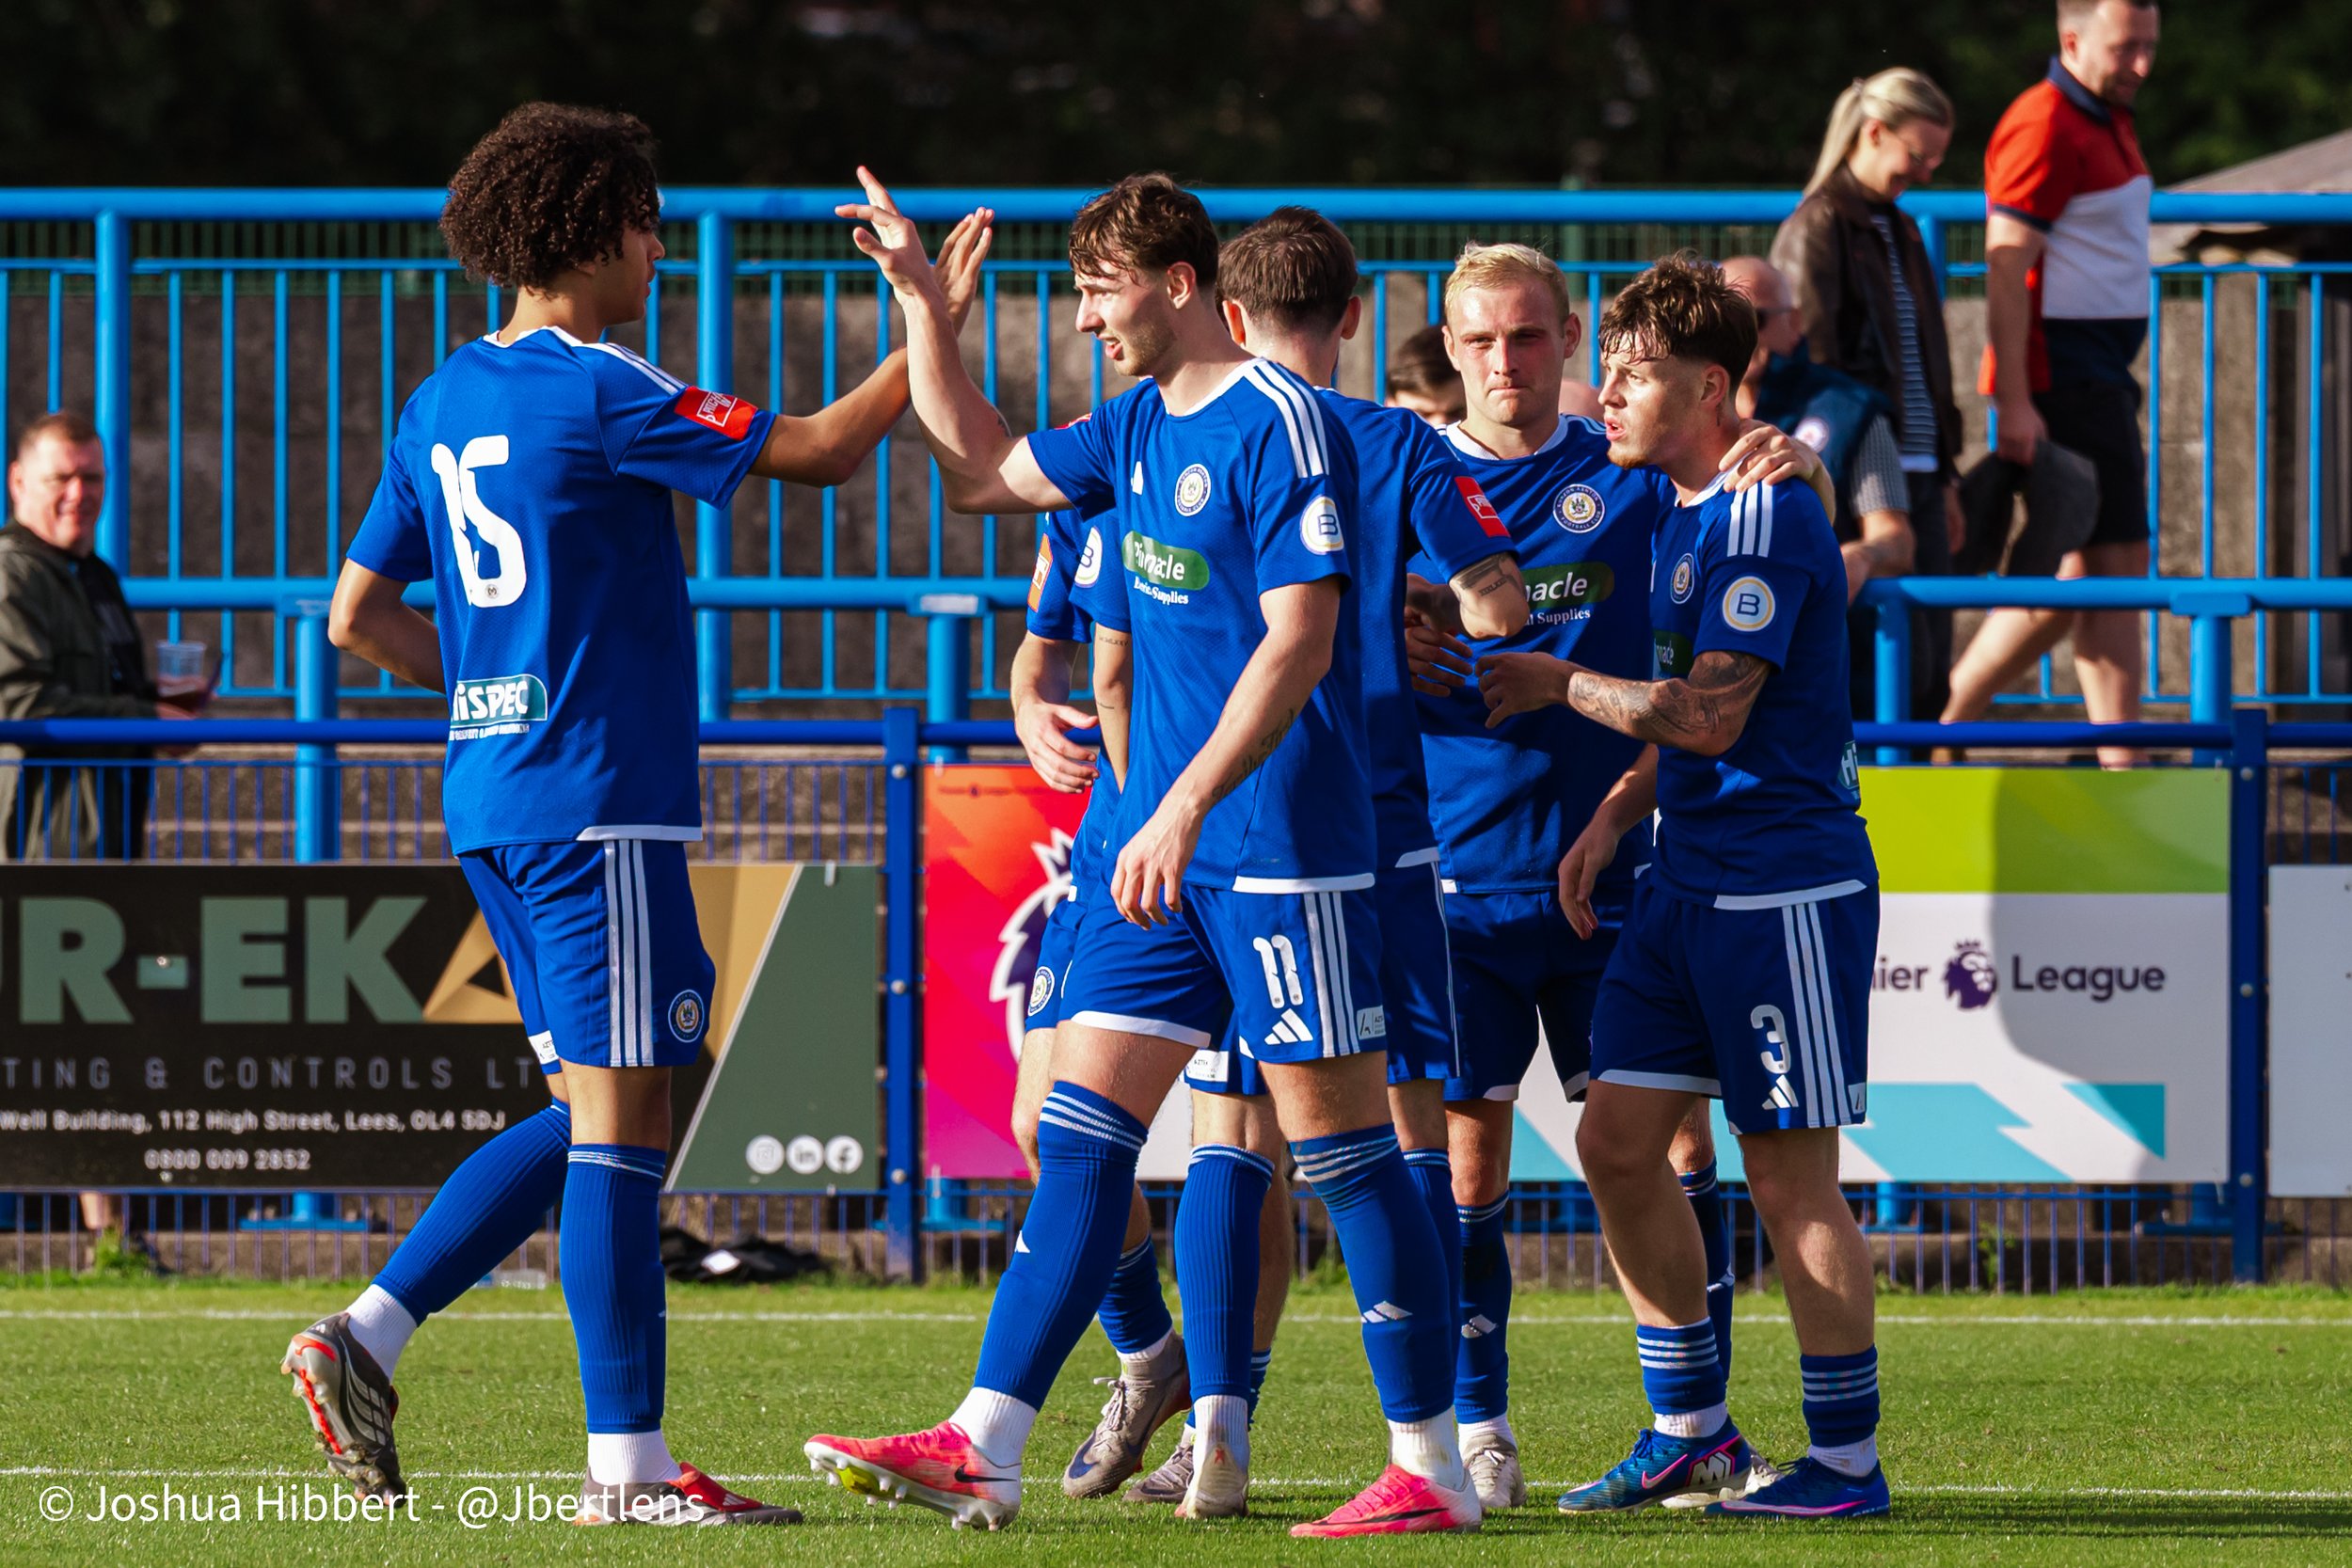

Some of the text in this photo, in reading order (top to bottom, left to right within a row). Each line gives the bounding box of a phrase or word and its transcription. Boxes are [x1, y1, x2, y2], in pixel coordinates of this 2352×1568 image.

[431, 434, 527, 609] 15
[1537, 608, 1591, 626] Supplies
[1737, 593, 1760, 616] B
[1253, 934, 1304, 1009] 11
[2011, 954, 2167, 1003] League
[1751, 1004, 1791, 1074] 3
[4, 1057, 110, 1089] TING
[145, 1057, 168, 1089] &
[203, 1056, 452, 1089] CONTROLS
[53, 1109, 152, 1134] Building,
[158, 1109, 200, 1131] 112
[205, 1109, 259, 1134] High
[263, 1109, 340, 1133] Street,
[344, 1109, 405, 1132] Lees,
[410, 1109, 455, 1131] OL4
